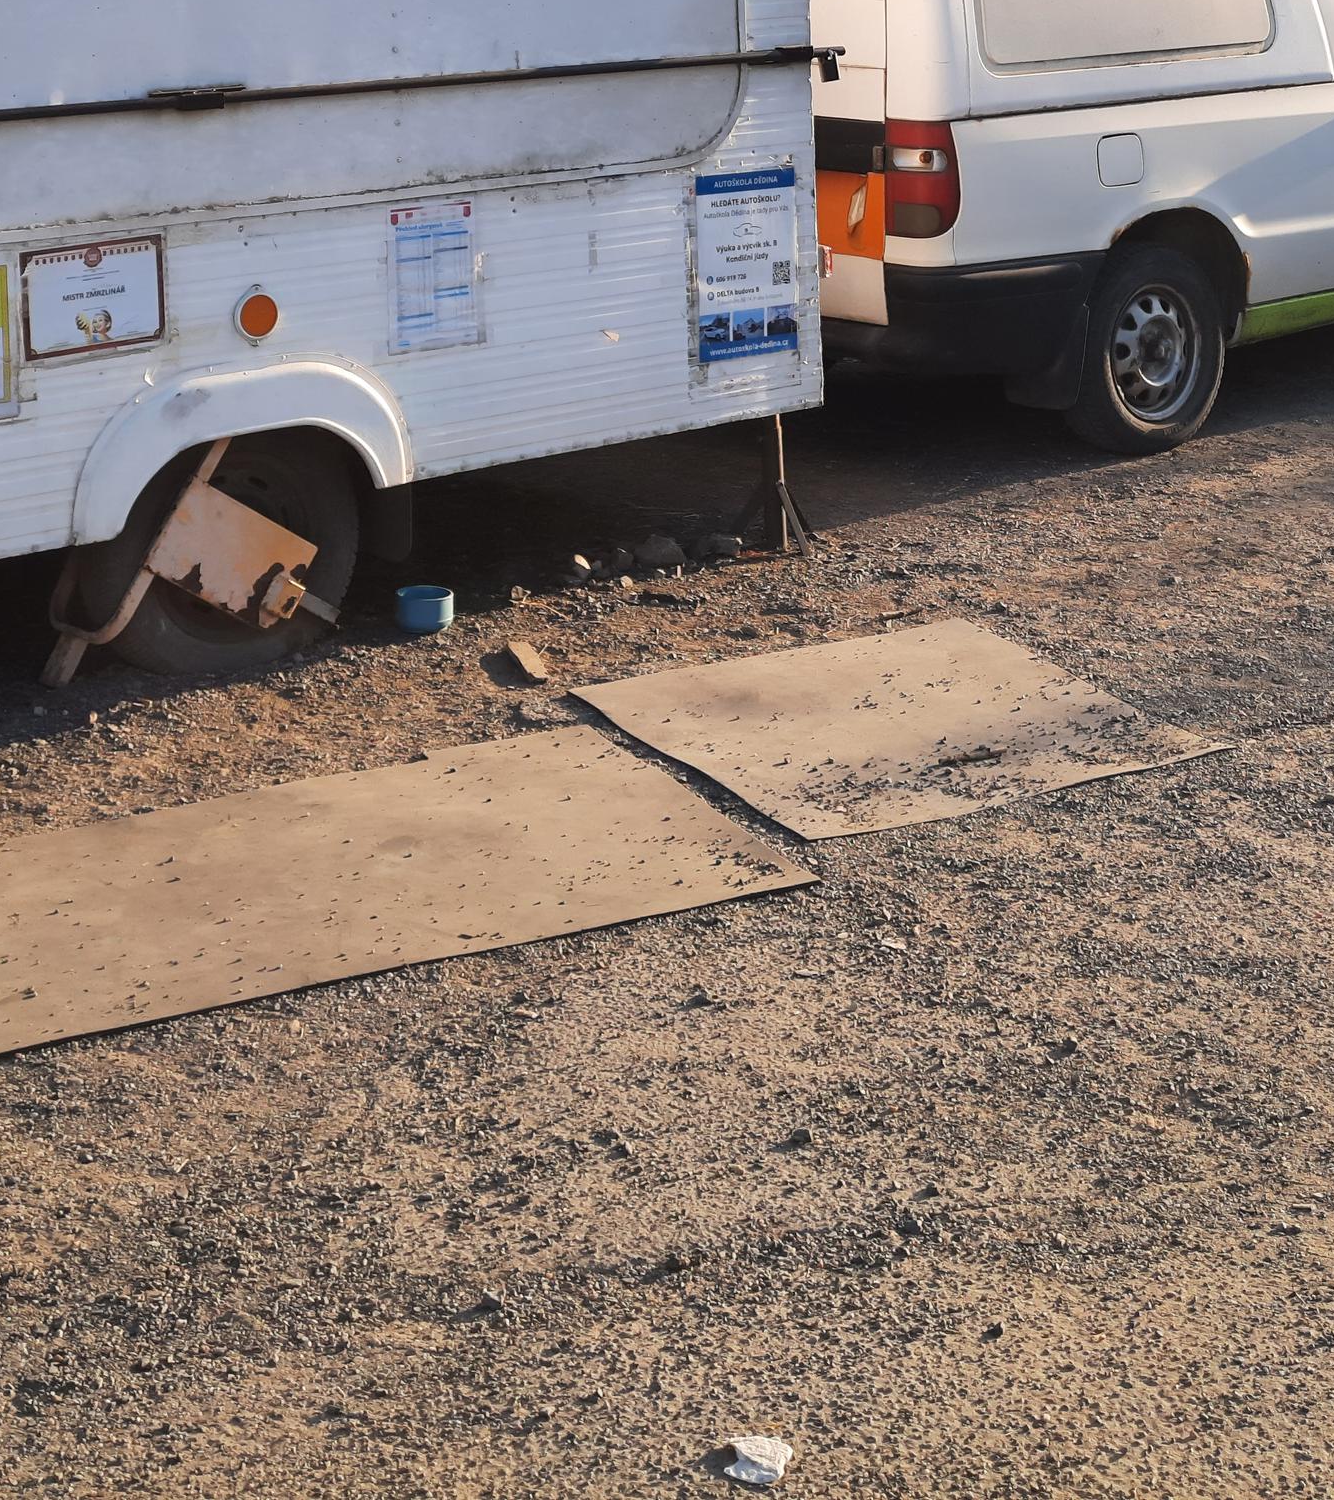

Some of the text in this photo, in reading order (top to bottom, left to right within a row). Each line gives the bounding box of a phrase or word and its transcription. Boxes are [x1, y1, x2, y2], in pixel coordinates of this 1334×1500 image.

[713, 175, 778, 188] AUTOŠKOLA DĚDINA
[710, 194, 781, 208] HLEDÁTE AUTOŠKOLU?
[716, 244, 736, 254] Výuka
[742, 241, 762, 251] výcvik
[763, 240, 772, 248] sk.
[725, 254, 753, 263] Kondiční
[62, 292, 85, 302] MISTR
[716, 289, 734, 298] DELTA
